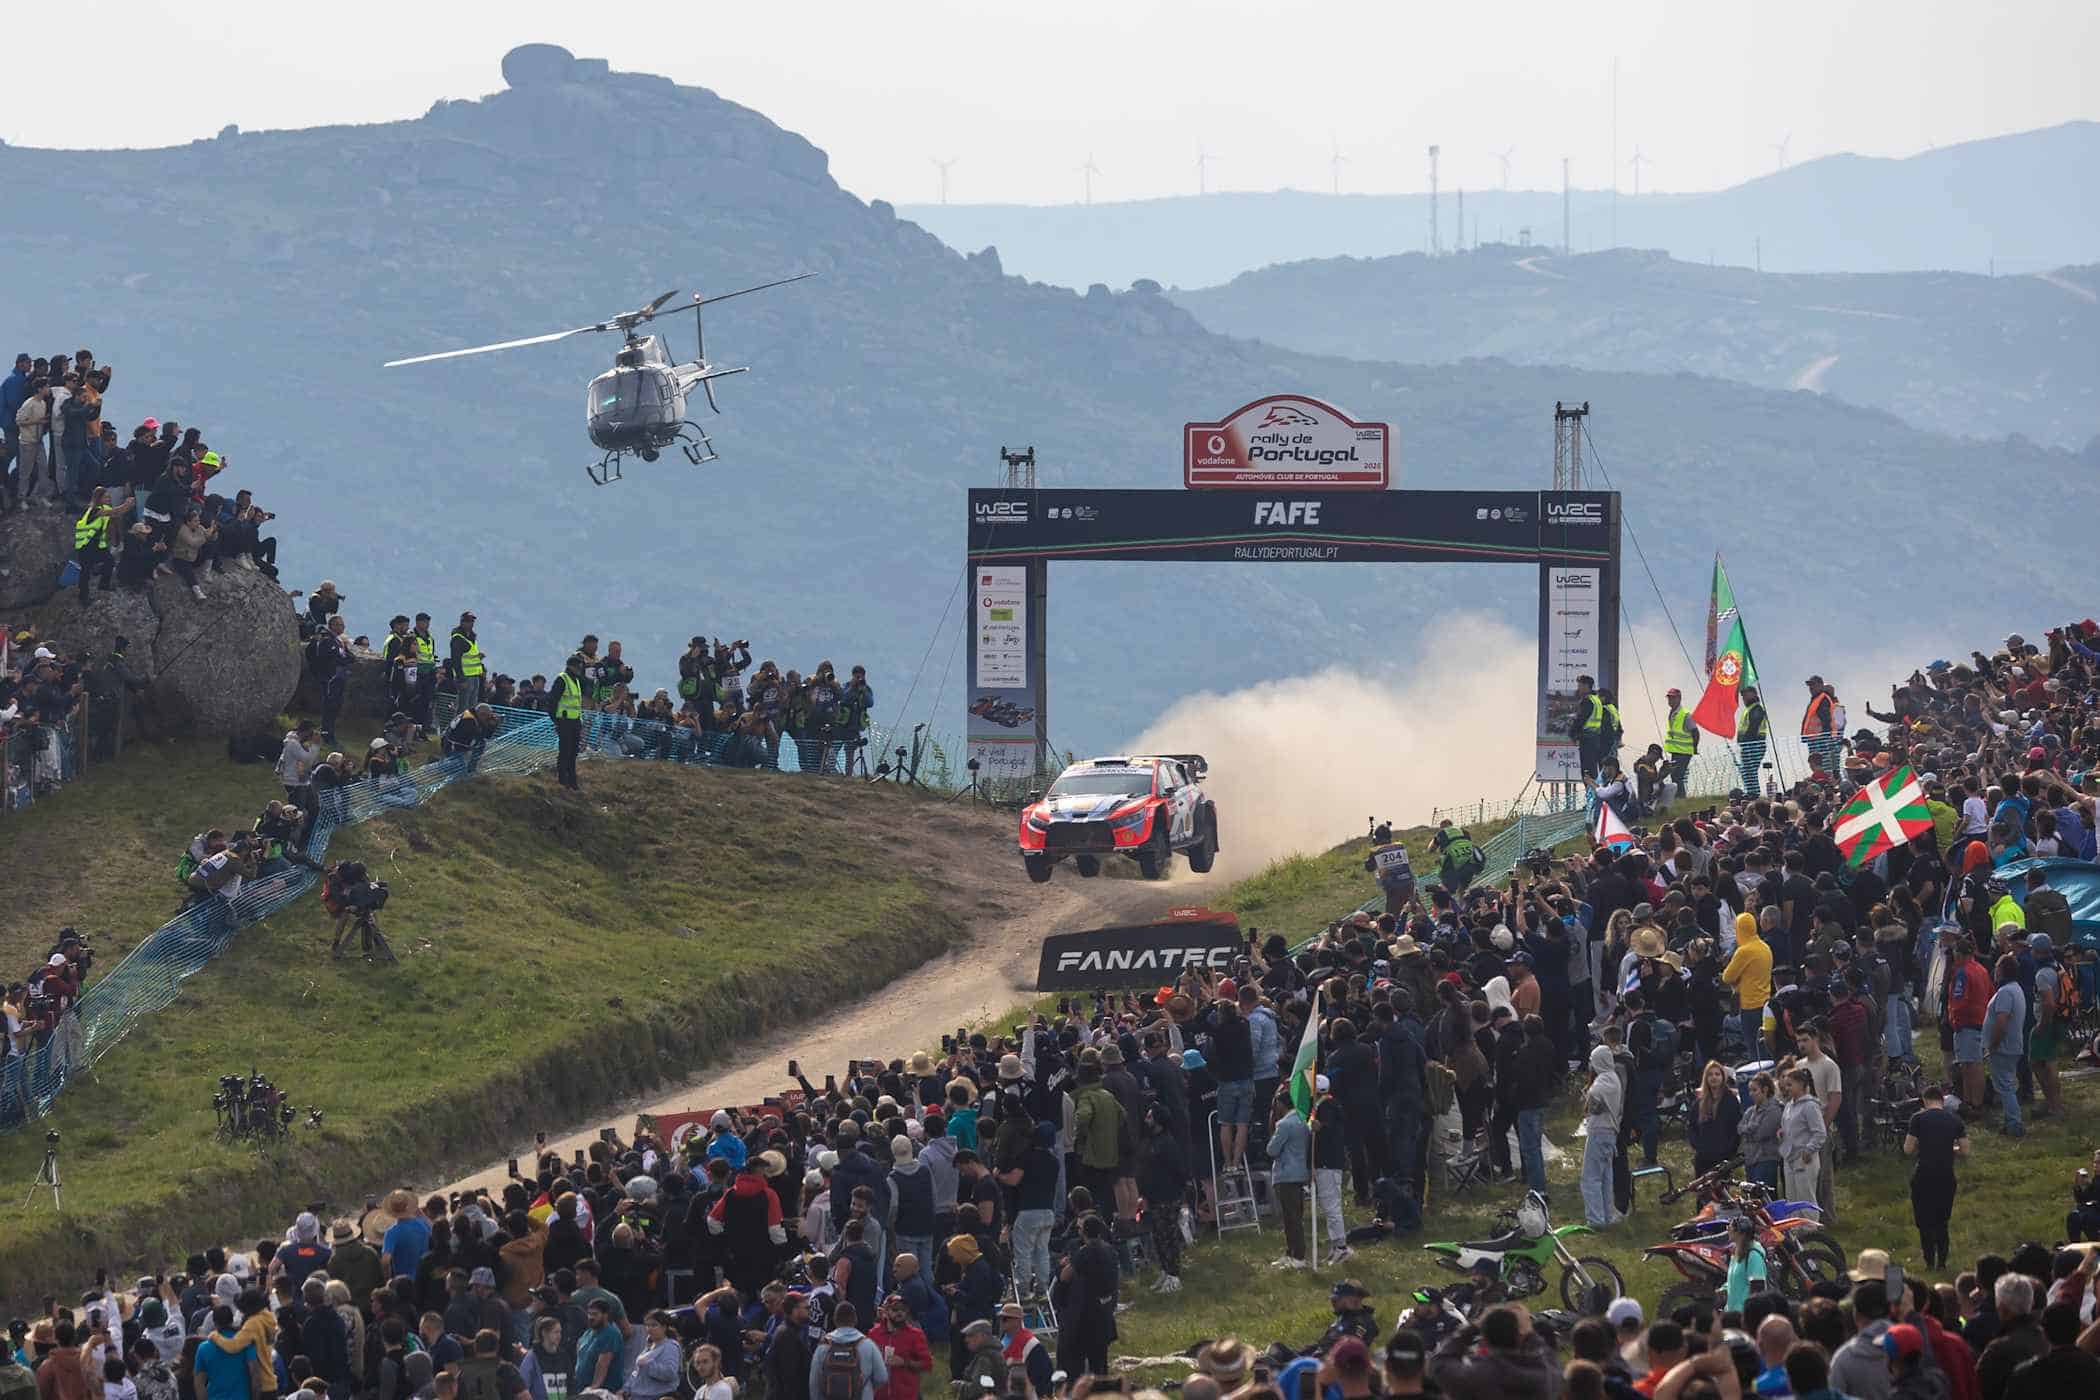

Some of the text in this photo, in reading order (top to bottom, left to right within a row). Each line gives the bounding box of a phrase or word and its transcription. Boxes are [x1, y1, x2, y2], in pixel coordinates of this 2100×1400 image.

[1250, 433, 1313, 447] rally de
[1197, 457, 1236, 465] vodafone
[1247, 446, 1359, 465] Portugal
[1235, 472, 1275, 480] AUTOMÓVEL
[976, 502, 1028, 514] WRC
[1254, 502, 1322, 525] FAFE
[1548, 503, 1602, 515] WRC
[1234, 547, 1339, 560] RALLYDEPORTUGAL.PT
[1556, 575, 1592, 584] WRC
[1382, 851, 1402, 863] 204
[1057, 947, 1232, 972] FANATEC
